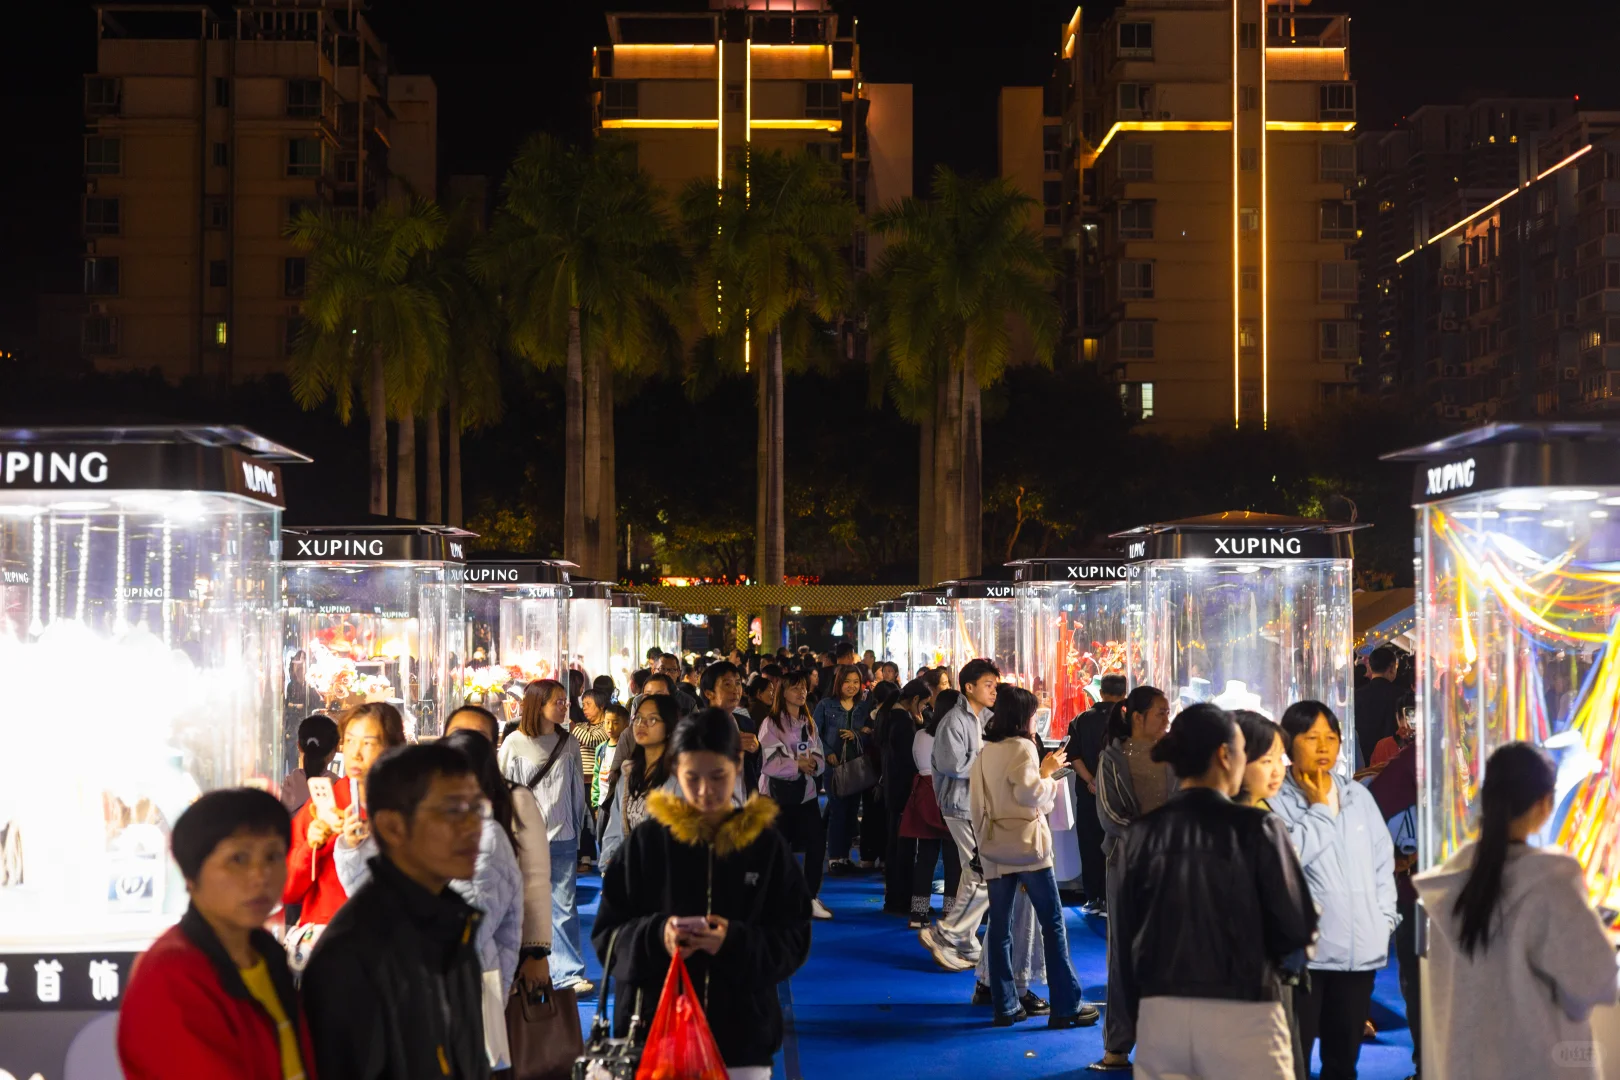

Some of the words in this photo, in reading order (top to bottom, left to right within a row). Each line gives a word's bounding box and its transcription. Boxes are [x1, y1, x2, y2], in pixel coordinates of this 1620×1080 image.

[0, 451, 108, 483] PING
[297, 539, 384, 556] XUPING
[1215, 537, 1301, 554] XUPING
[4, 571, 29, 583] XUPING
[1067, 566, 1127, 578] XUPING
[115, 587, 163, 598] XUPING
[319, 605, 351, 614] XUPING
